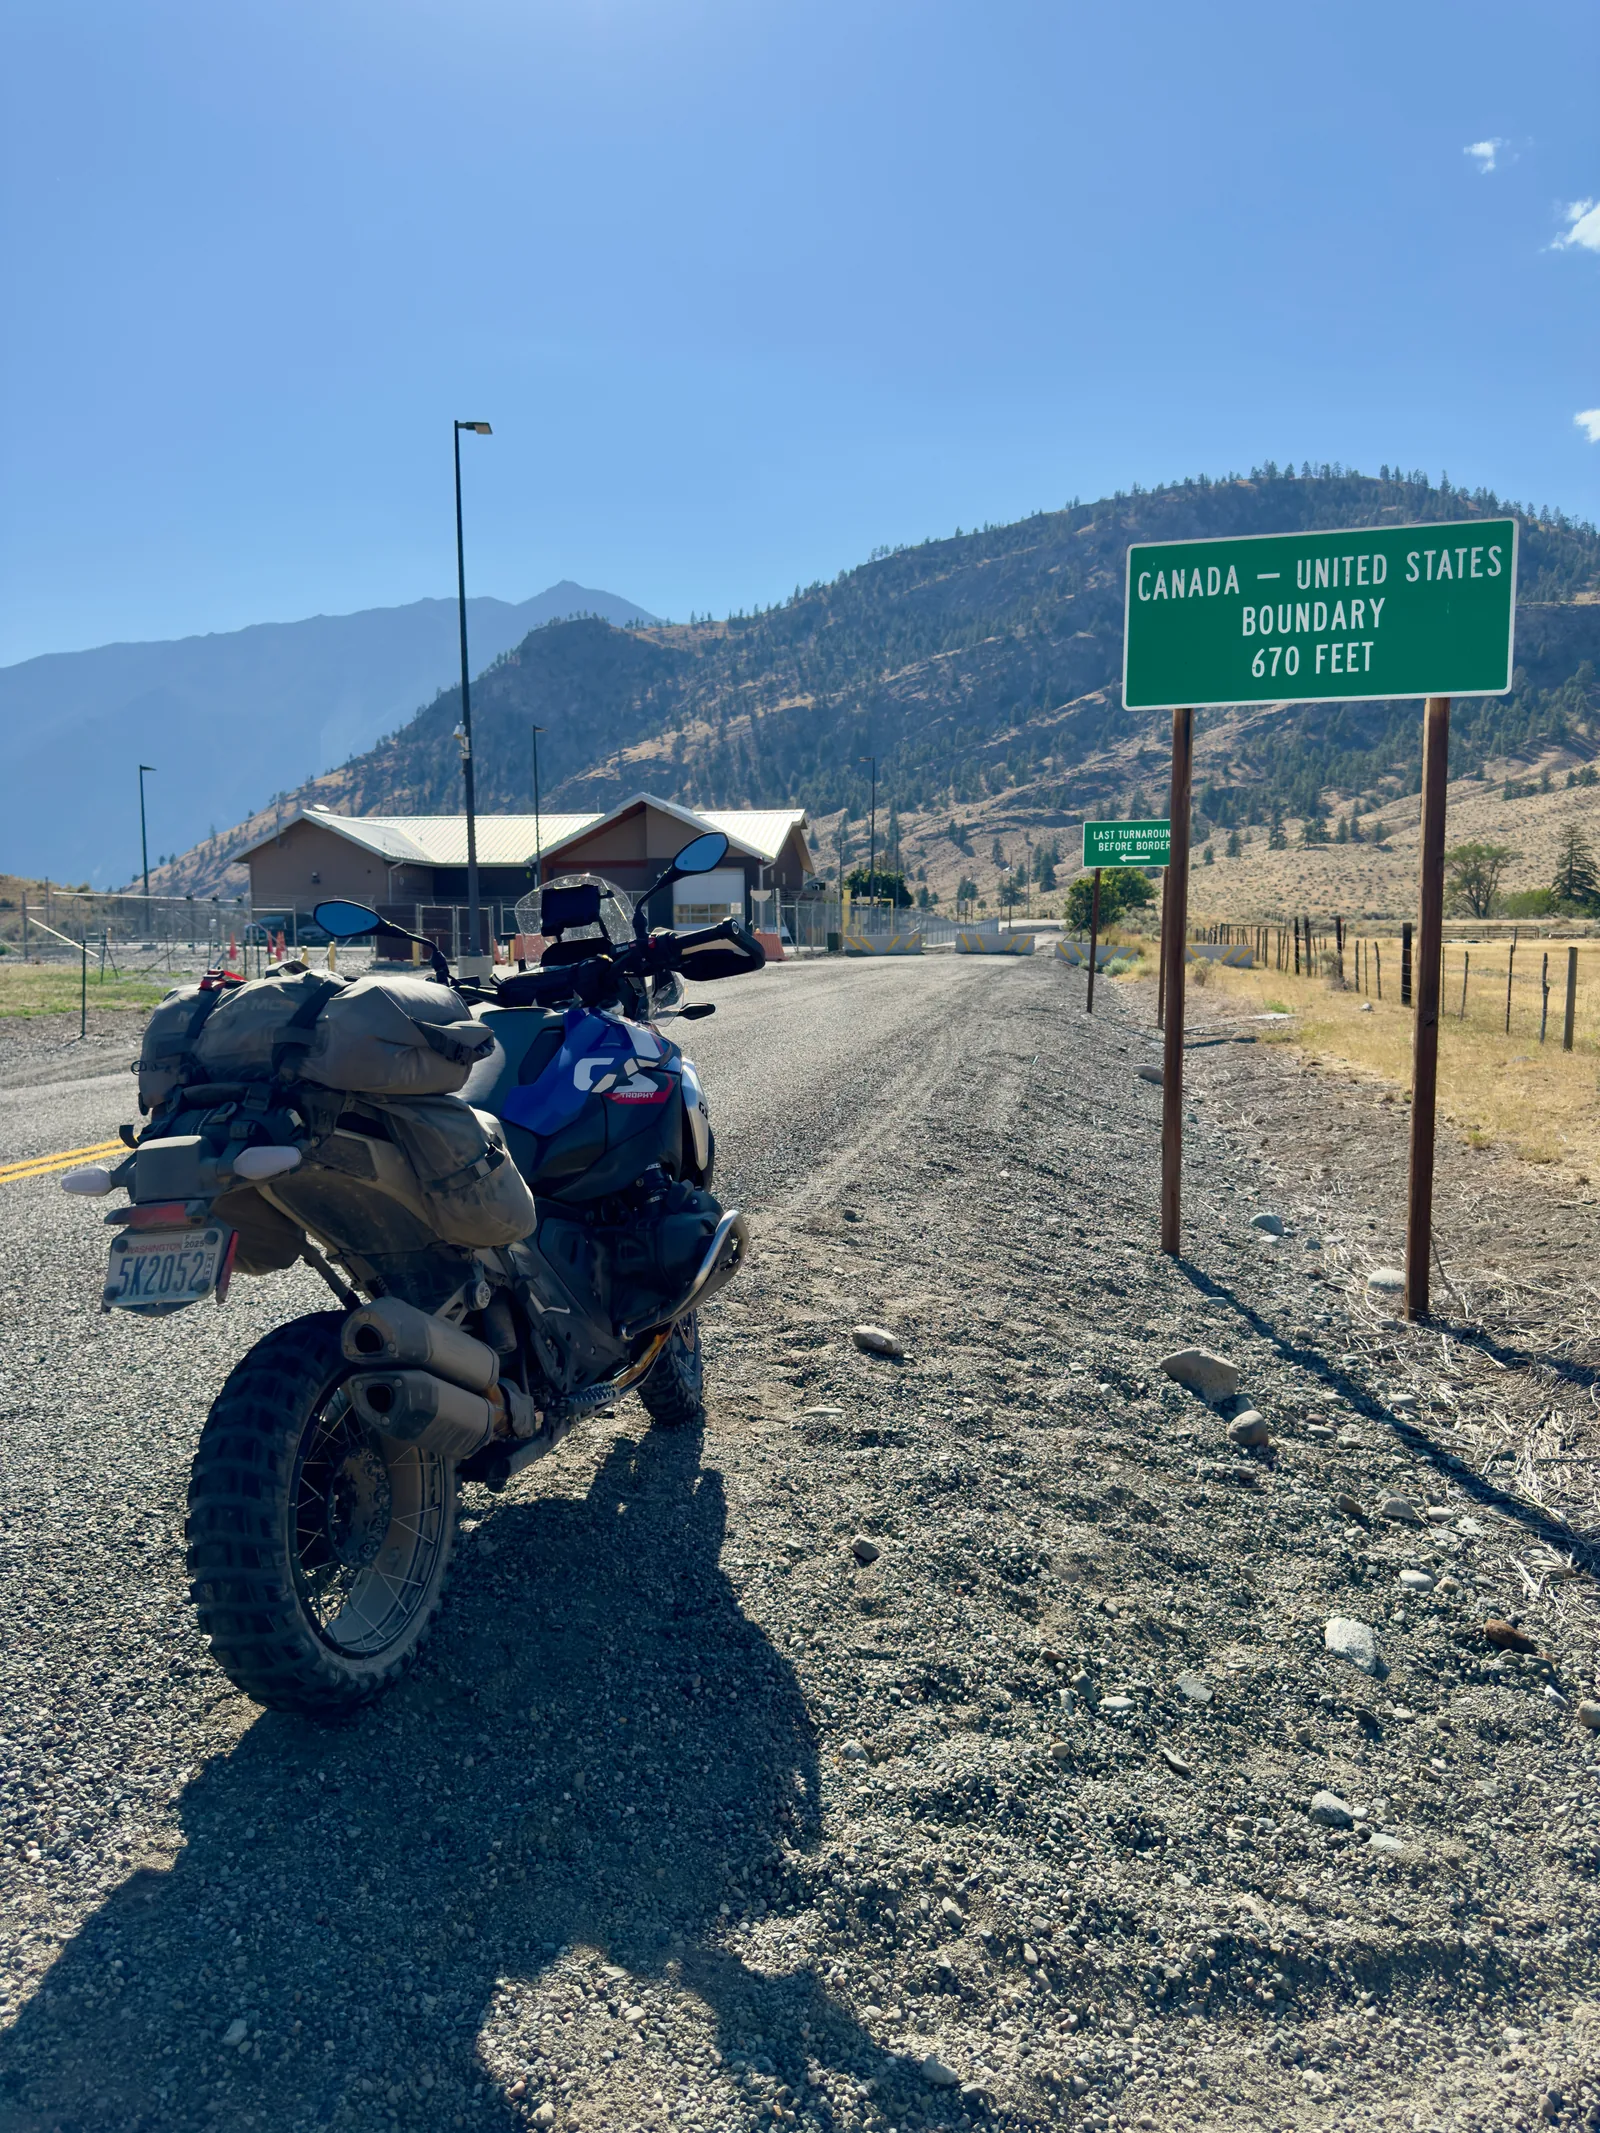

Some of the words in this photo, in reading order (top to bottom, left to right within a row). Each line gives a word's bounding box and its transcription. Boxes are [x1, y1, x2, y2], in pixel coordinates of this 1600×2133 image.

[1137, 564, 1240, 602] CANADA
[1296, 553, 1388, 590] UNITED
[1405, 545, 1503, 583] STATES
[1242, 597, 1386, 637] BOUNDARY
[1251, 645, 1300, 678] 670
[1315, 641, 1374, 674] FEET
[1093, 830, 1115, 840] LAST
[1118, 829, 1171, 840] TURNAROUN
[1098, 841, 1133, 852] BEFORE
[573, 1057, 660, 1094] GS
[184, 1240, 205, 1249] 2025
[118, 1251, 205, 1297] 5K2052
